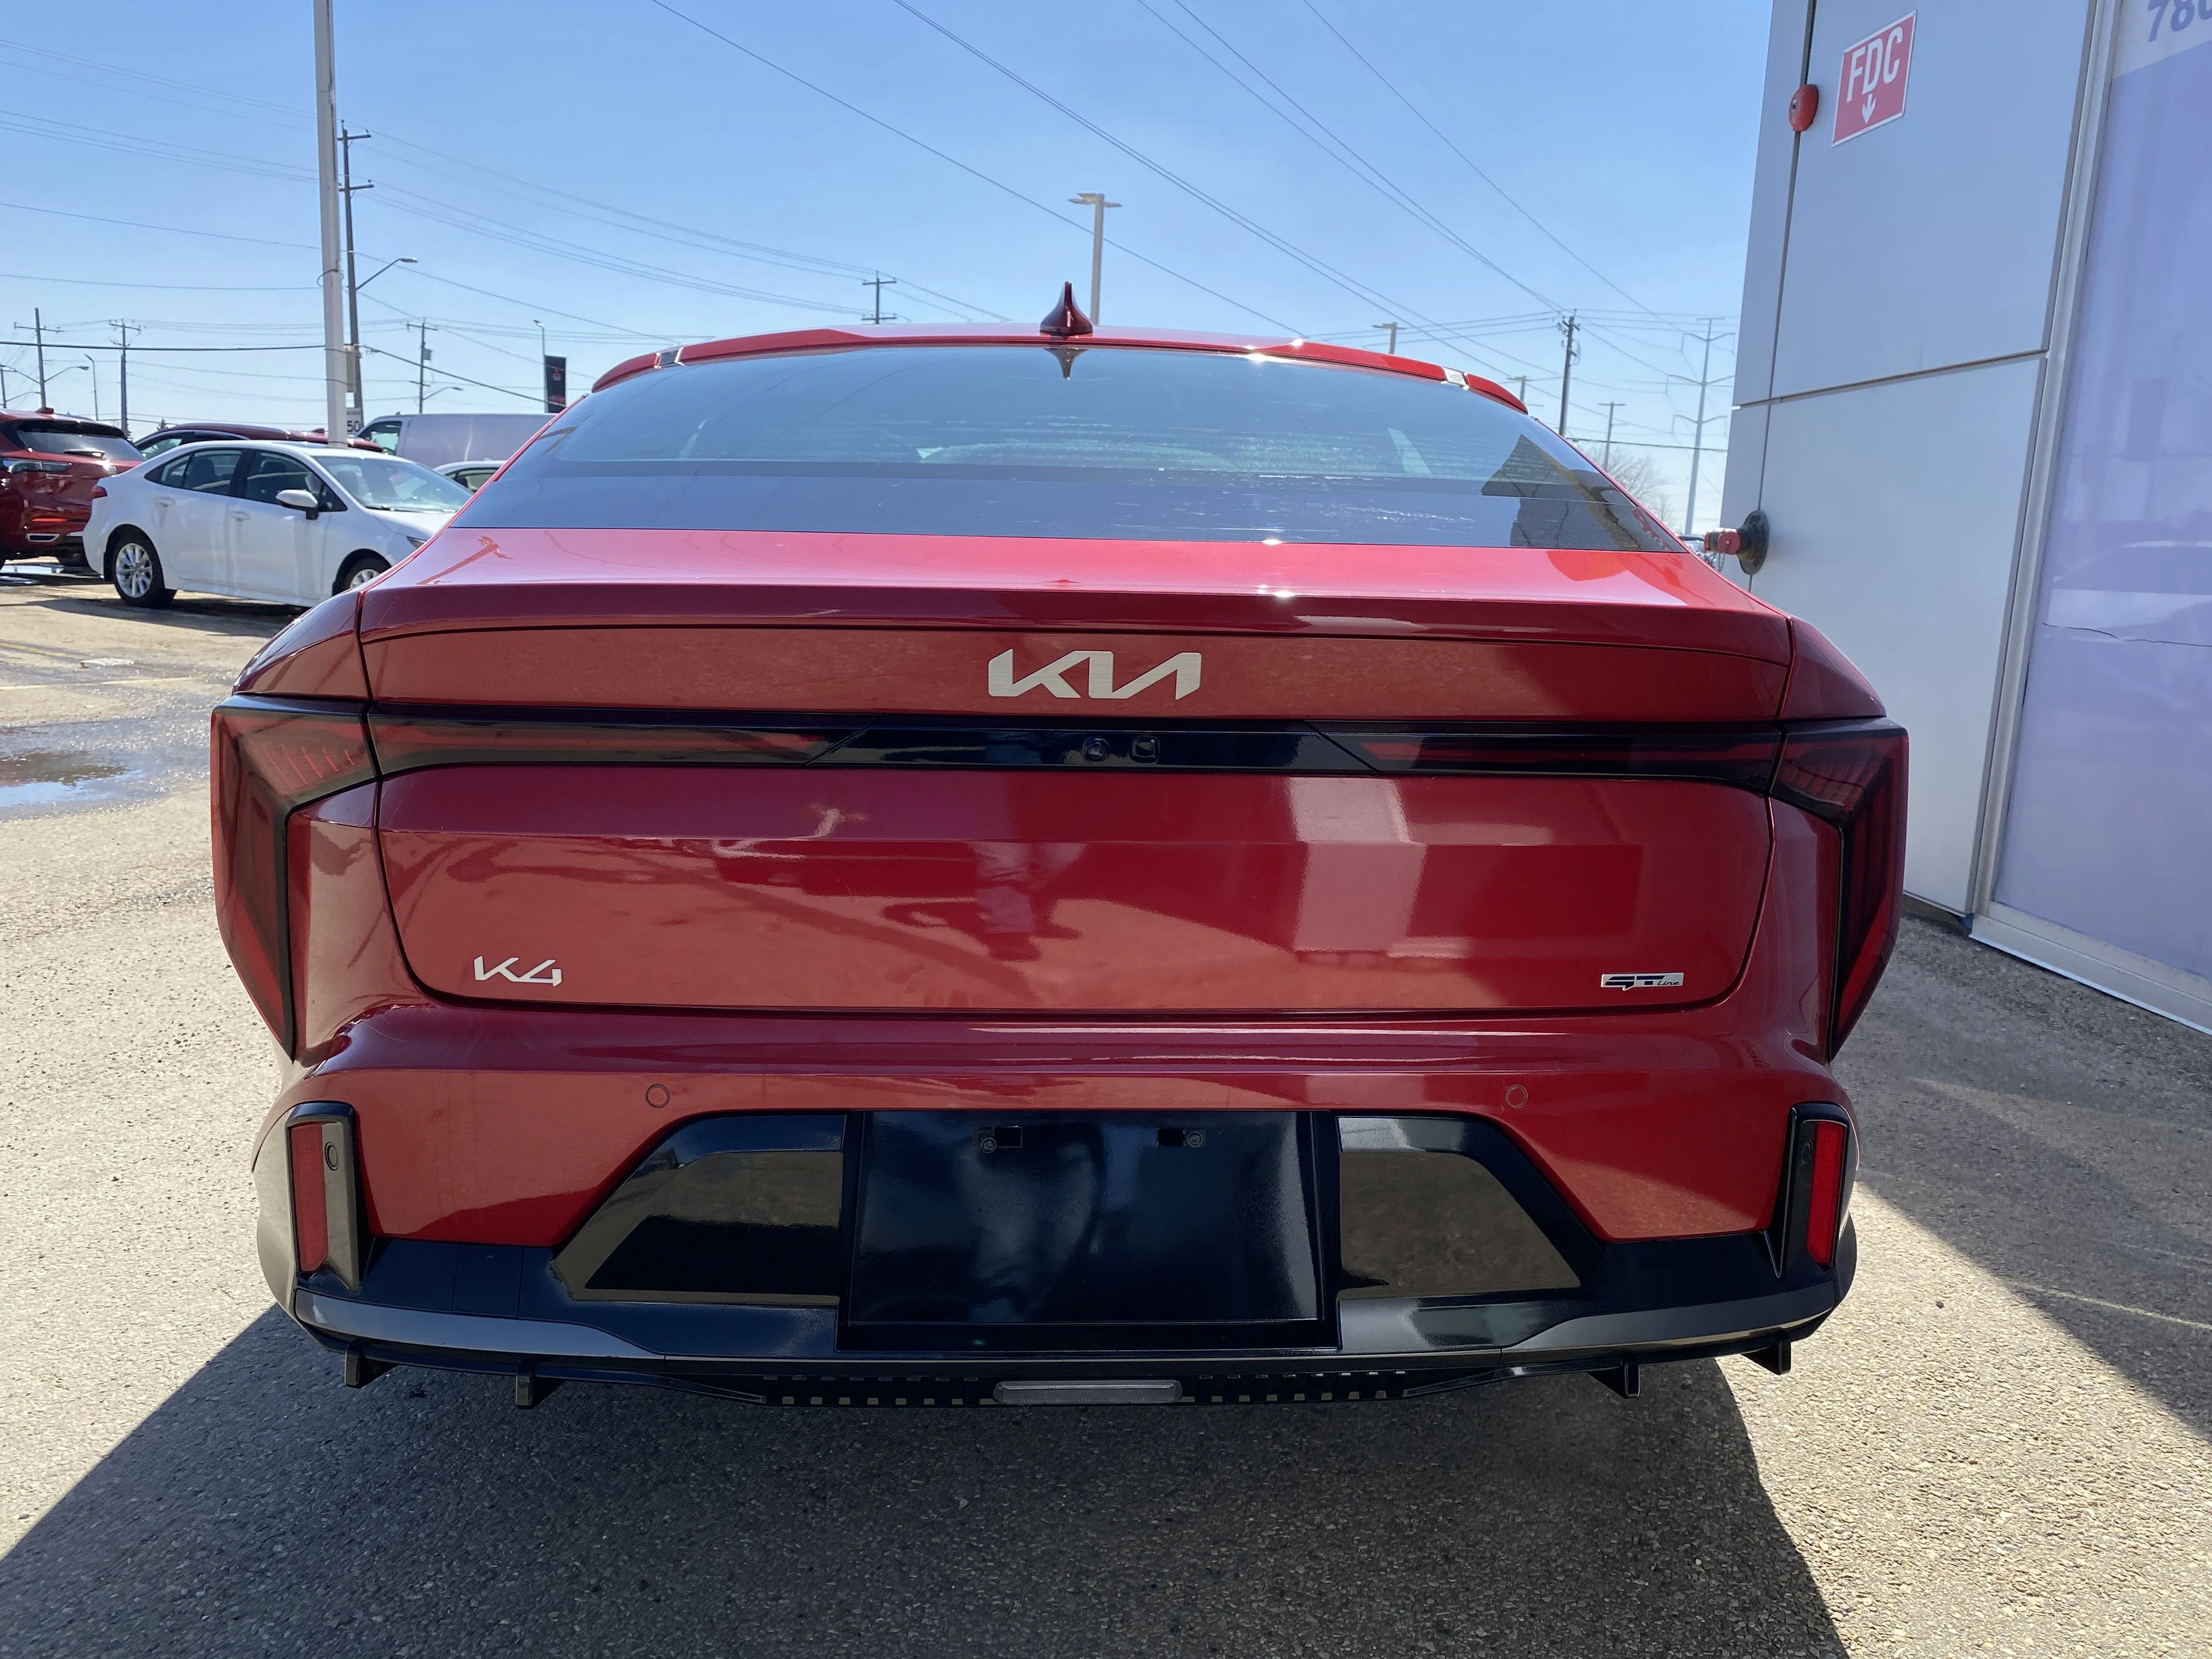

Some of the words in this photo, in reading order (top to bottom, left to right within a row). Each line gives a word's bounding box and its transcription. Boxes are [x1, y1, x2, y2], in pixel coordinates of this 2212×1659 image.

[1847, 26, 1903, 103] FDC
[347, 420, 360, 432] 50
[989, 648, 1201, 700] KIA
[474, 955, 563, 987] K4
